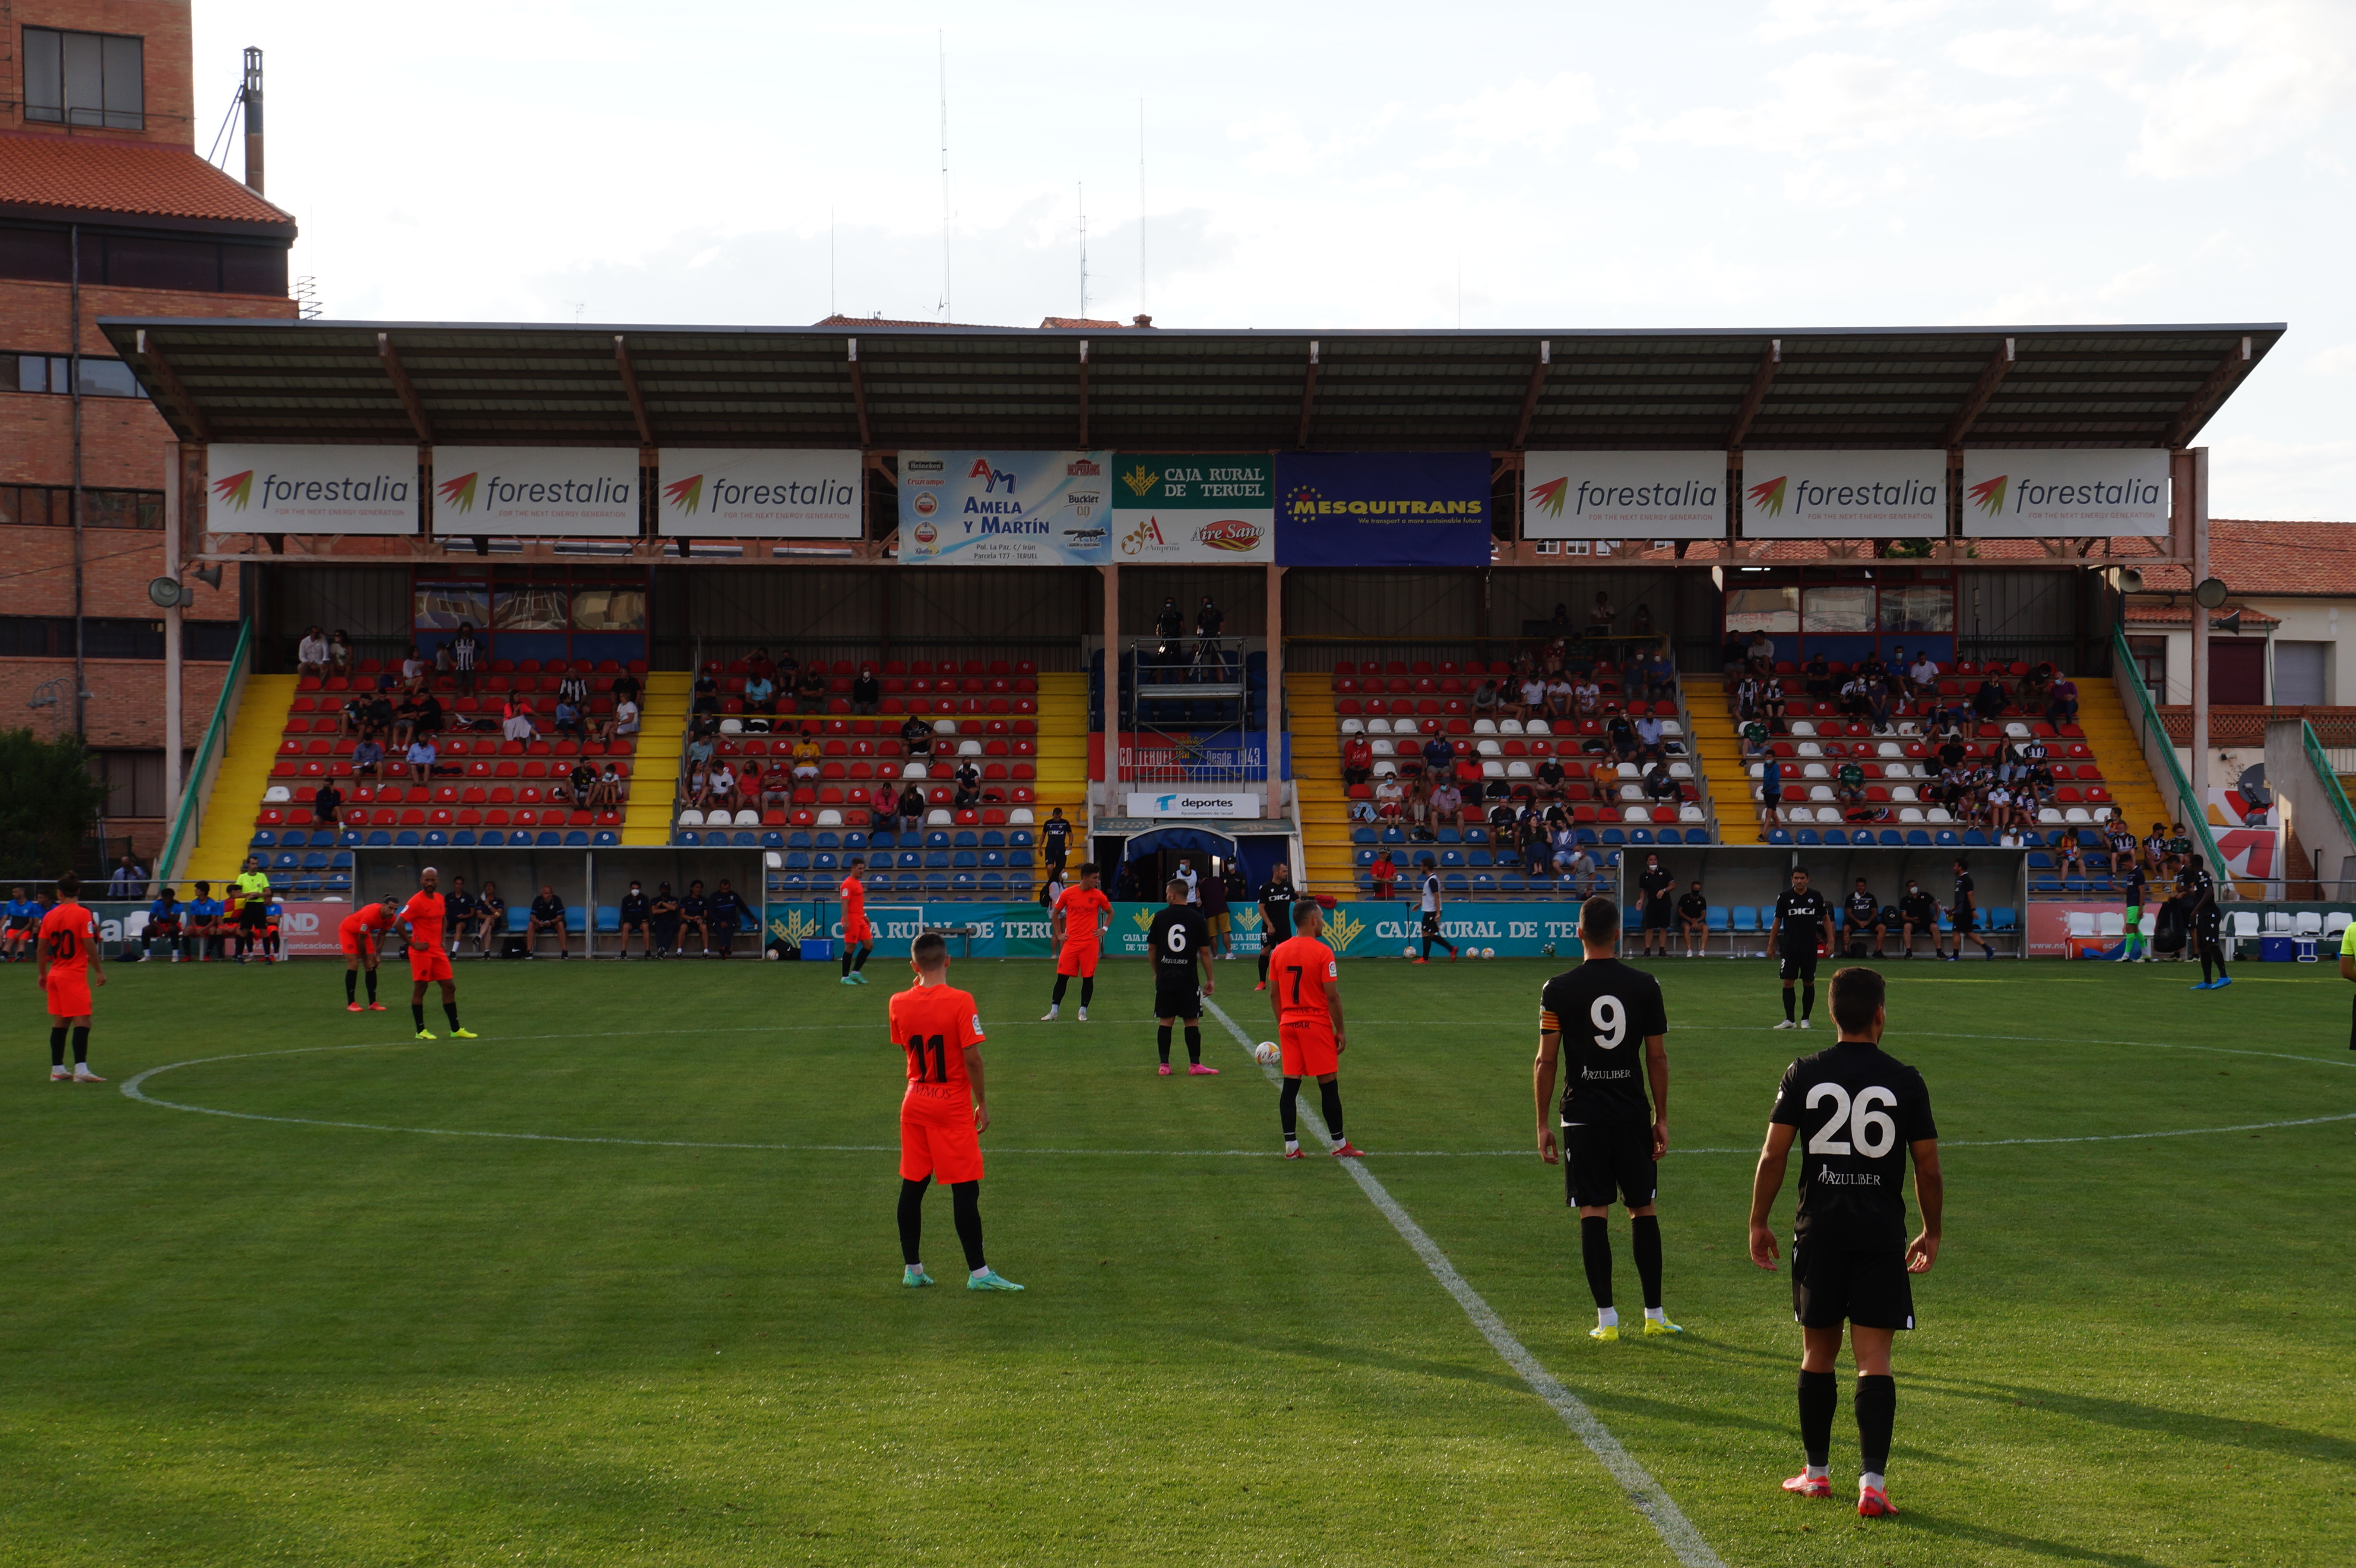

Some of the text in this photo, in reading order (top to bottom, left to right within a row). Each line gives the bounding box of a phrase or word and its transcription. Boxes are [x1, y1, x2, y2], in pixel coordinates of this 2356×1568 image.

[1068, 464, 1100, 476] DESPERADOS
[1165, 468, 1264, 482] CAJA RURAL
[263, 474, 408, 509] forestalia
[487, 477, 630, 511] forestalia
[712, 478, 853, 513] forestalia
[1165, 484, 1265, 496] DE TERUEL
[1577, 480, 1717, 515] forestalia
[1796, 479, 1937, 515] forestalia
[2016, 478, 2159, 513] forestalia
[1068, 495, 1099, 503] Buckler
[1294, 500, 1482, 515] MESQUITRANS
[1191, 524, 1265, 541] Aire Sano
[1119, 747, 1132, 765] CD
[1206, 750, 1232, 765] Desde
[1181, 798, 1233, 809] deportes
[1788, 907, 1815, 916] DIGI
[965, 922, 994, 939] DE
[1001, 921, 1053, 939] TERU
[1123, 934, 1141, 942] CAJA
[1168, 923, 1186, 952] 6
[1439, 921, 1502, 938] URAL
[1509, 921, 1537, 938] DE
[1286, 966, 1303, 1005] 7
[1590, 995, 1626, 1050] 9
[909, 1034, 947, 1083] 11
[1586, 1069, 1631, 1081] AZULIBER
[1806, 1082, 1898, 1158] 26
[1825, 1173, 1881, 1186] AZULIBER
